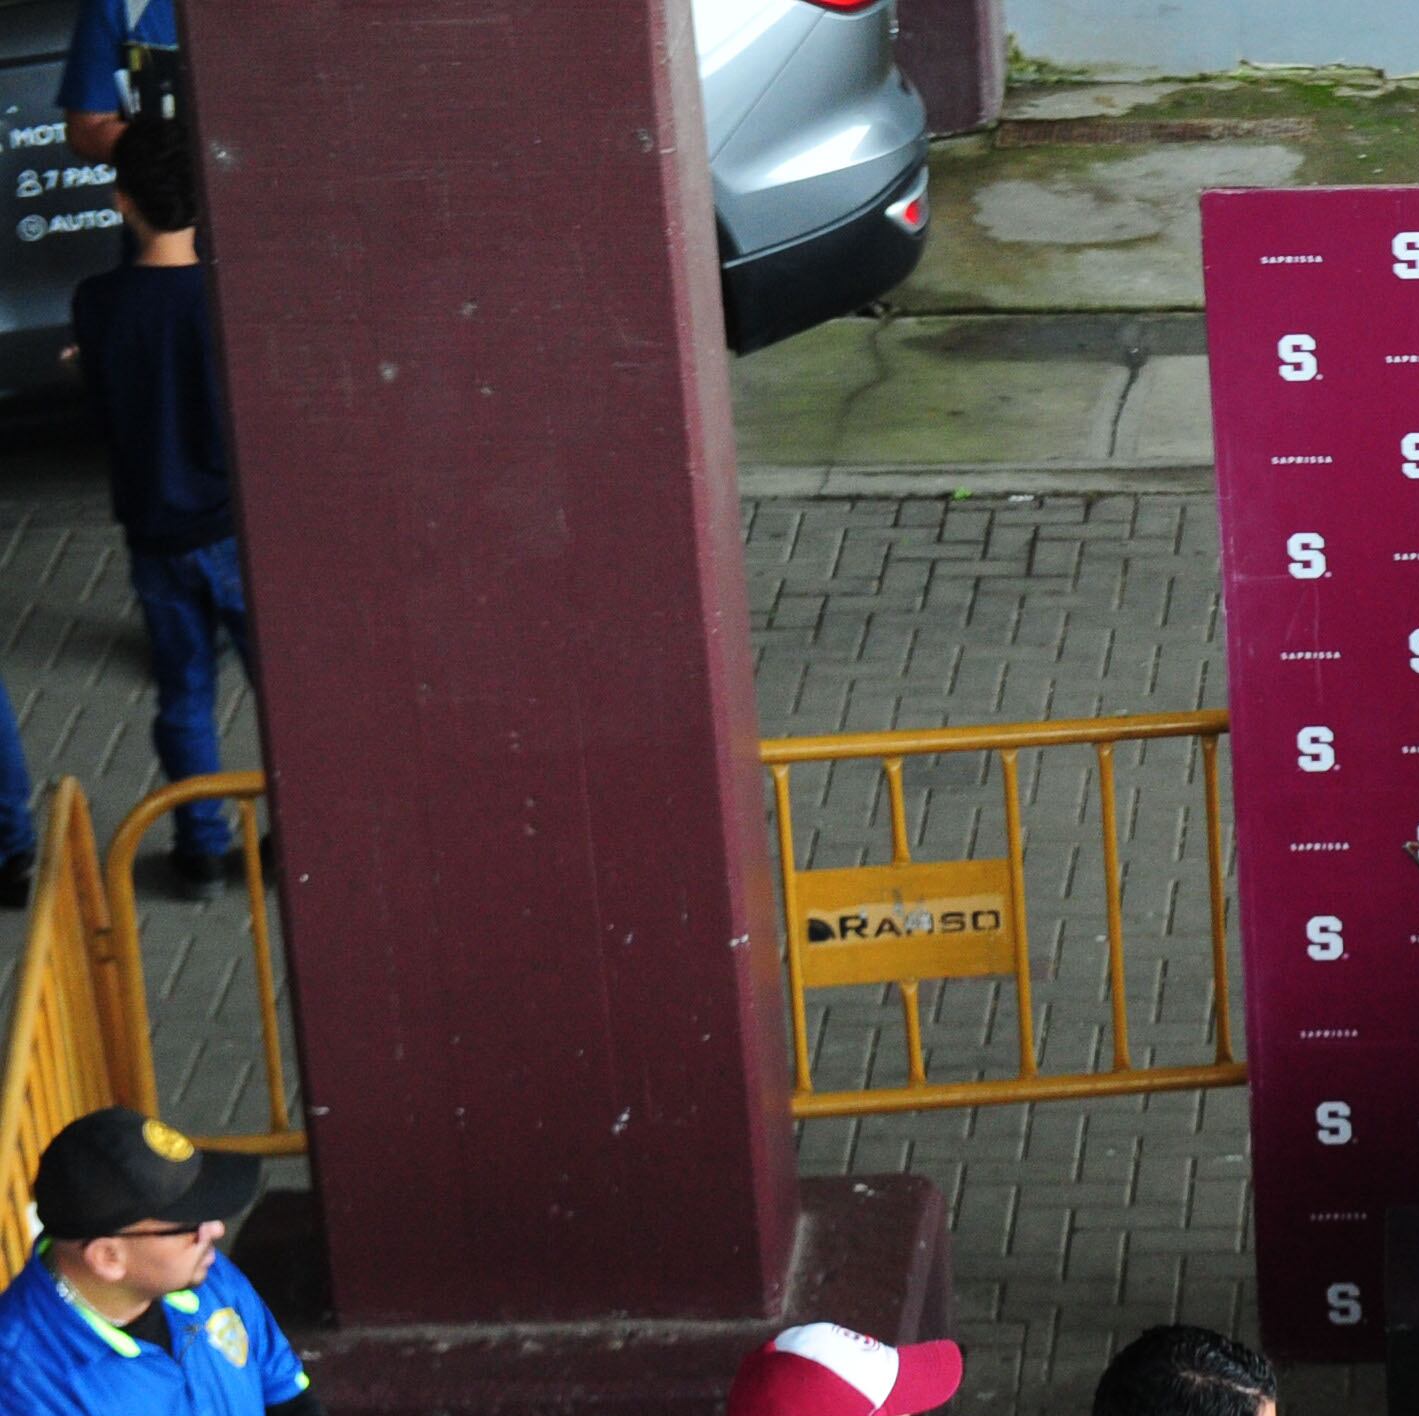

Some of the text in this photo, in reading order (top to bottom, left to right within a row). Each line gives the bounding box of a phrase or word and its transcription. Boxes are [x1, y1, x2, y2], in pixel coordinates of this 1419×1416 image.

[1259, 254, 1324, 265] SAPRISSA
[1277, 334, 1317, 381] S
[1270, 455, 1334, 465] SAPRISSA
[1287, 533, 1326, 579] S
[1279, 650, 1342, 661] SAPRISSA
[1296, 726, 1334, 772] S
[1289, 841, 1350, 852] SAPRISSA
[1306, 915, 1342, 961] S
[1316, 1101, 1352, 1145] S
[1327, 1284, 1361, 1323] S
